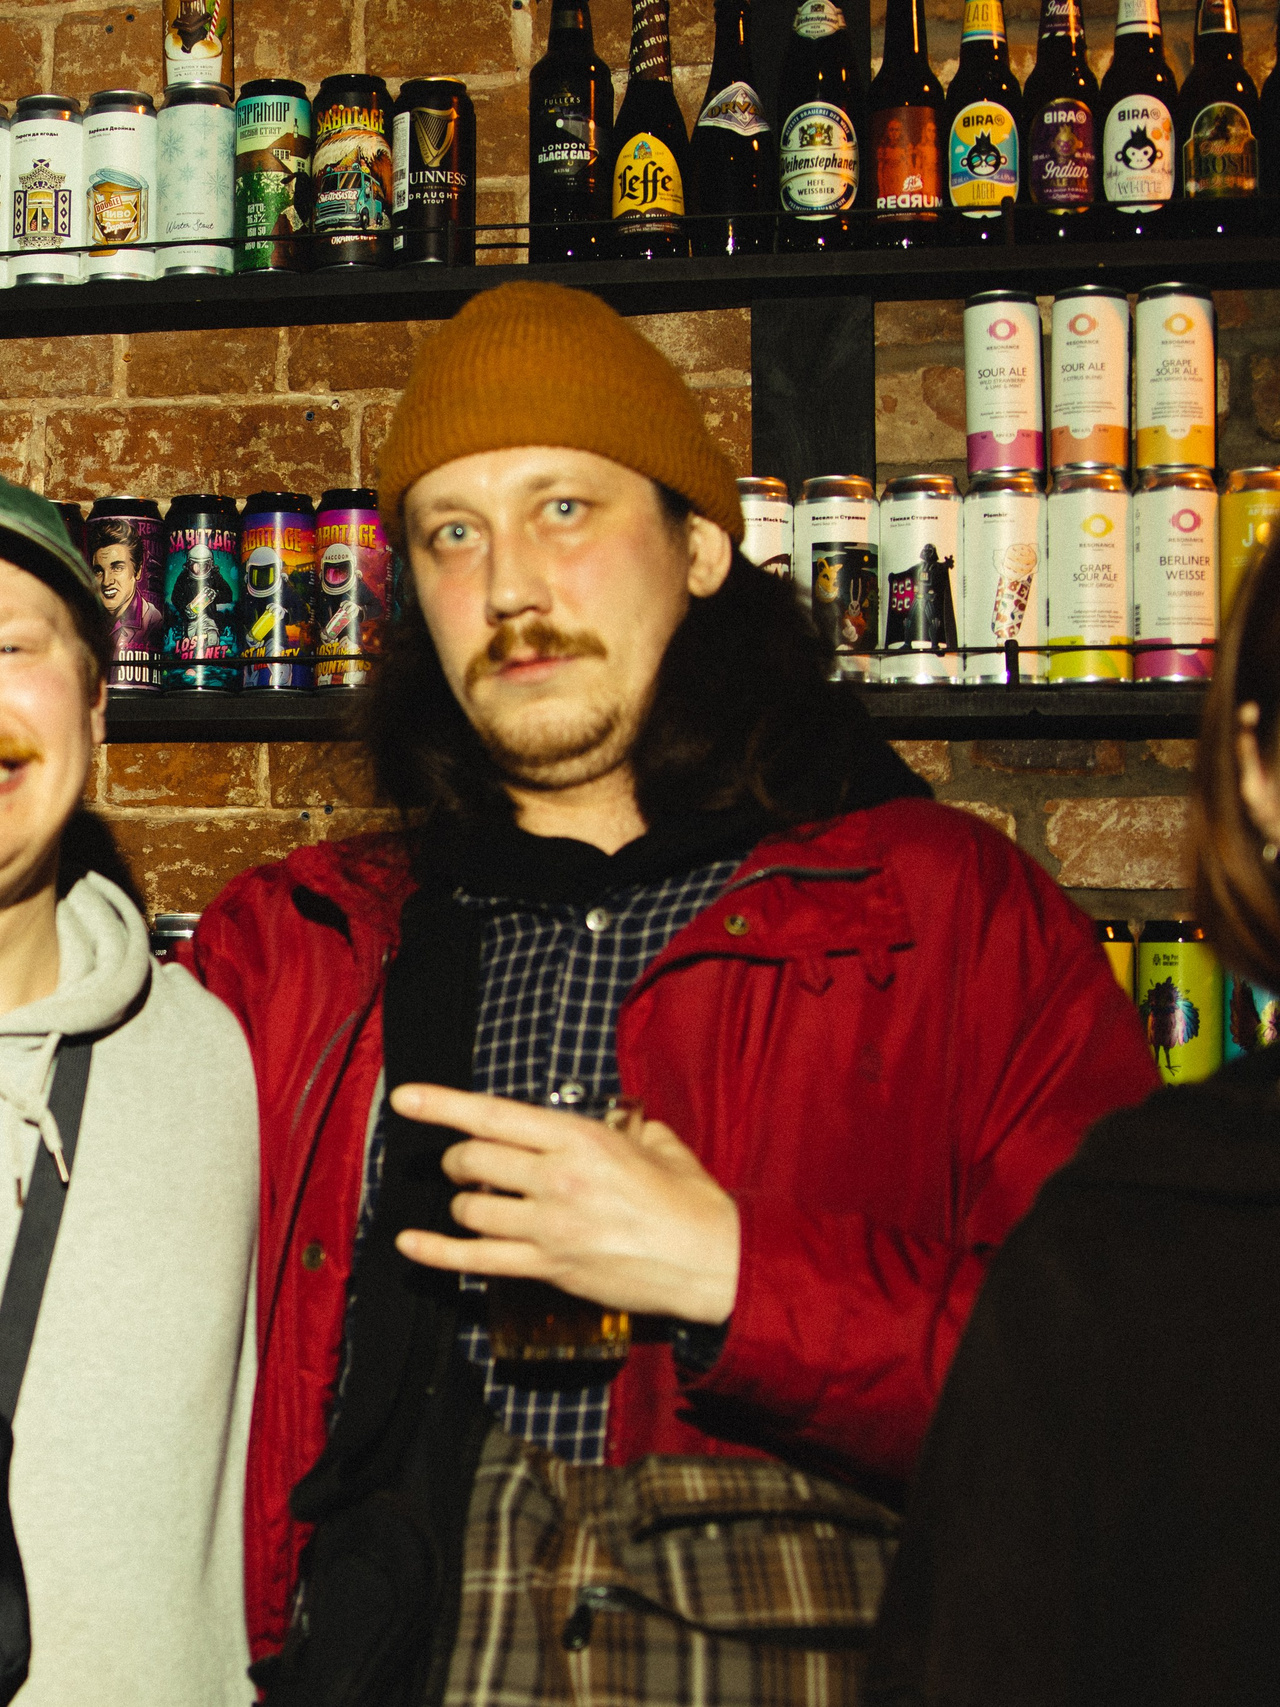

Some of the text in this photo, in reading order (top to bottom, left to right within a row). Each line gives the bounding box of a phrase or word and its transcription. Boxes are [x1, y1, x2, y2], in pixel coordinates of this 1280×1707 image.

[635, 55, 665, 73] BRUIN
[800, 107, 829, 118] BRAUEREI
[1044, 110, 1076, 124] BIRA
[1118, 108, 1150, 122] BIRA
[317, 105, 385, 135] SABOTAGE
[962, 115, 994, 128] BIRA
[542, 142, 586, 152] LONDON
[538, 150, 591, 164] BLACK CAB
[1042, 159, 1089, 180] Indian
[409, 170, 468, 187] UINNESS
[617, 160, 673, 206] Leffe
[807, 179, 825, 187] HEFE
[408, 192, 459, 201] DRAUGHT
[797, 187, 835, 196] WEISSBIER
[972, 183, 995, 200] LAGER
[102, 208, 131, 219] ПИВО
[1061, 362, 1106, 373] SOUR ALE
[1162, 359, 1192, 368] GRAPE
[978, 366, 1027, 379] SOUR ALE
[1156, 367, 1198, 376] SOUR ALE
[242, 527, 302, 552] ABOTAGE
[1159, 555, 1211, 566] BERLINER
[1080, 564, 1112, 572] GRAPE
[1073, 573, 1118, 582] SOUR ALE
[1165, 570, 1206, 580] WEISSE
[175, 633, 208, 653] LOST
